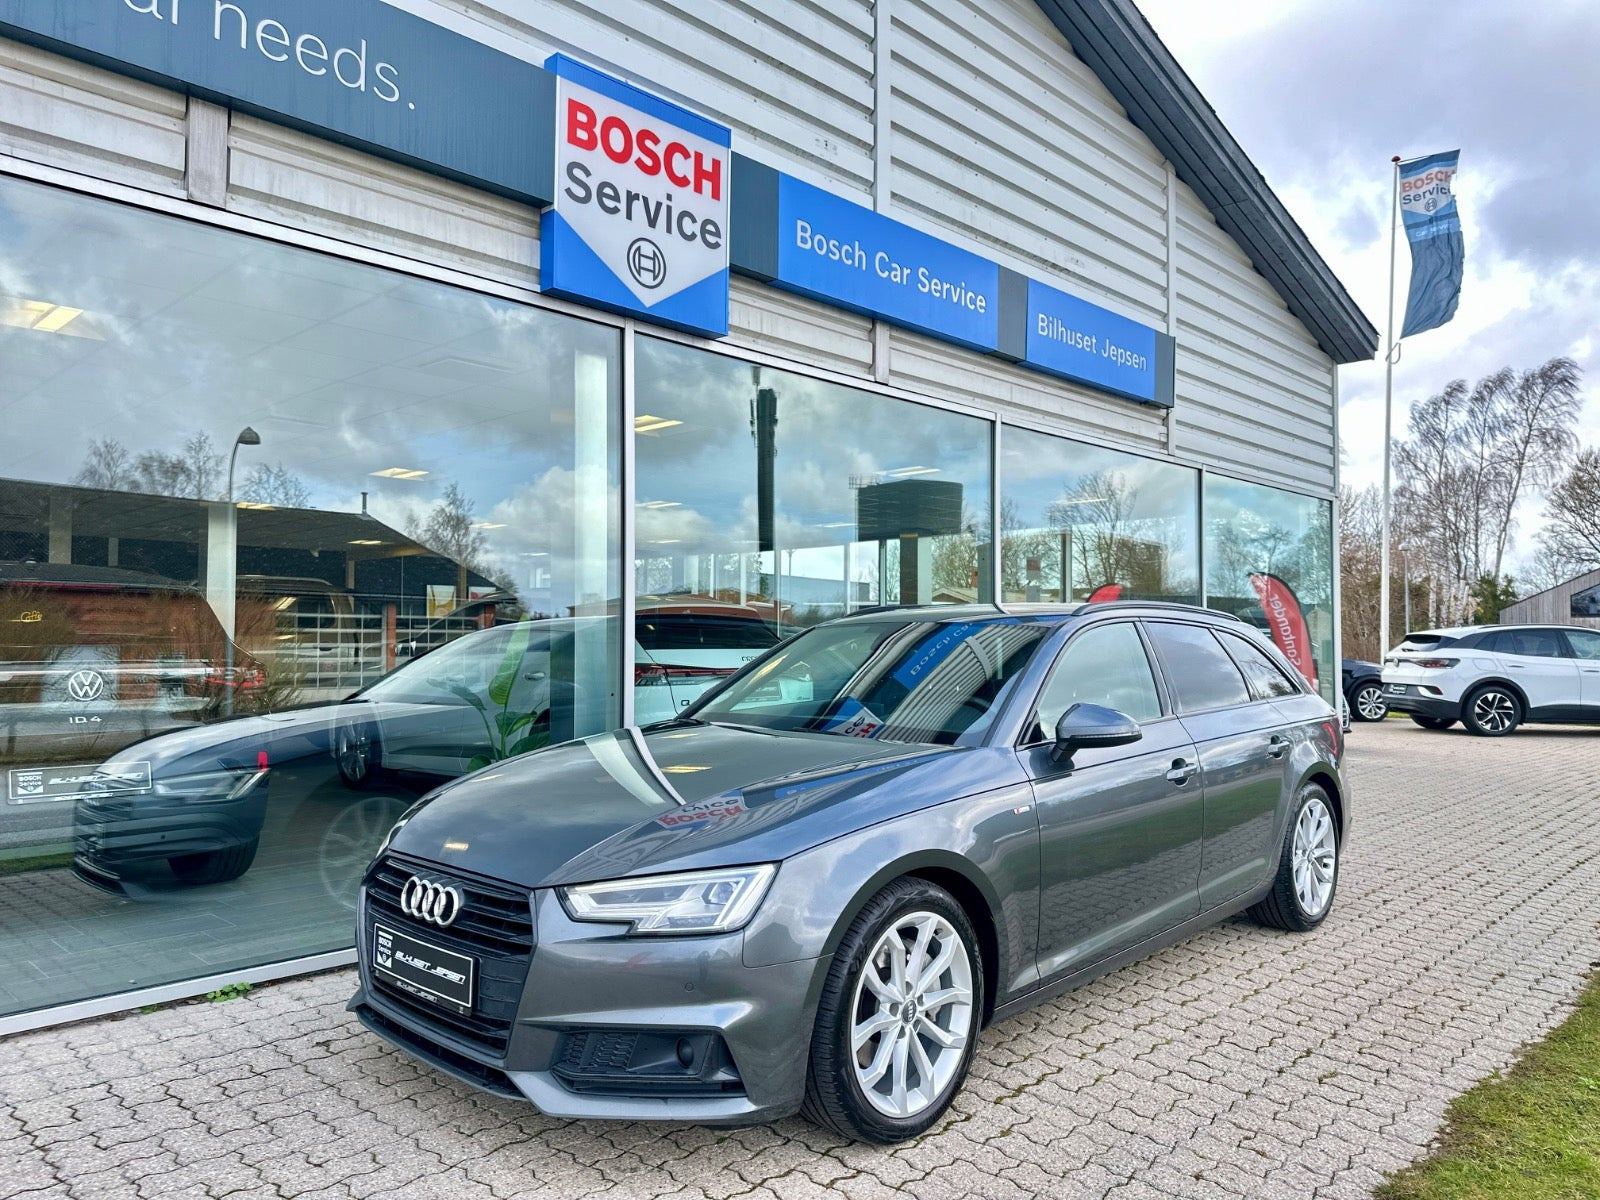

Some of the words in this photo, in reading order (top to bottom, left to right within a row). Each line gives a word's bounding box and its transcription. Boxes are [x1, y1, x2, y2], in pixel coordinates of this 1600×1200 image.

[213, 0, 416, 110] needs.
[567, 97, 721, 202] BOSCH
[564, 161, 722, 250] Service
[796, 219, 867, 271] Bosch
[875, 251, 911, 285] Car
[917, 267, 987, 314] Service
[1038, 313, 1097, 354] Bilhuset
[1101, 338, 1147, 372] Jepsen
